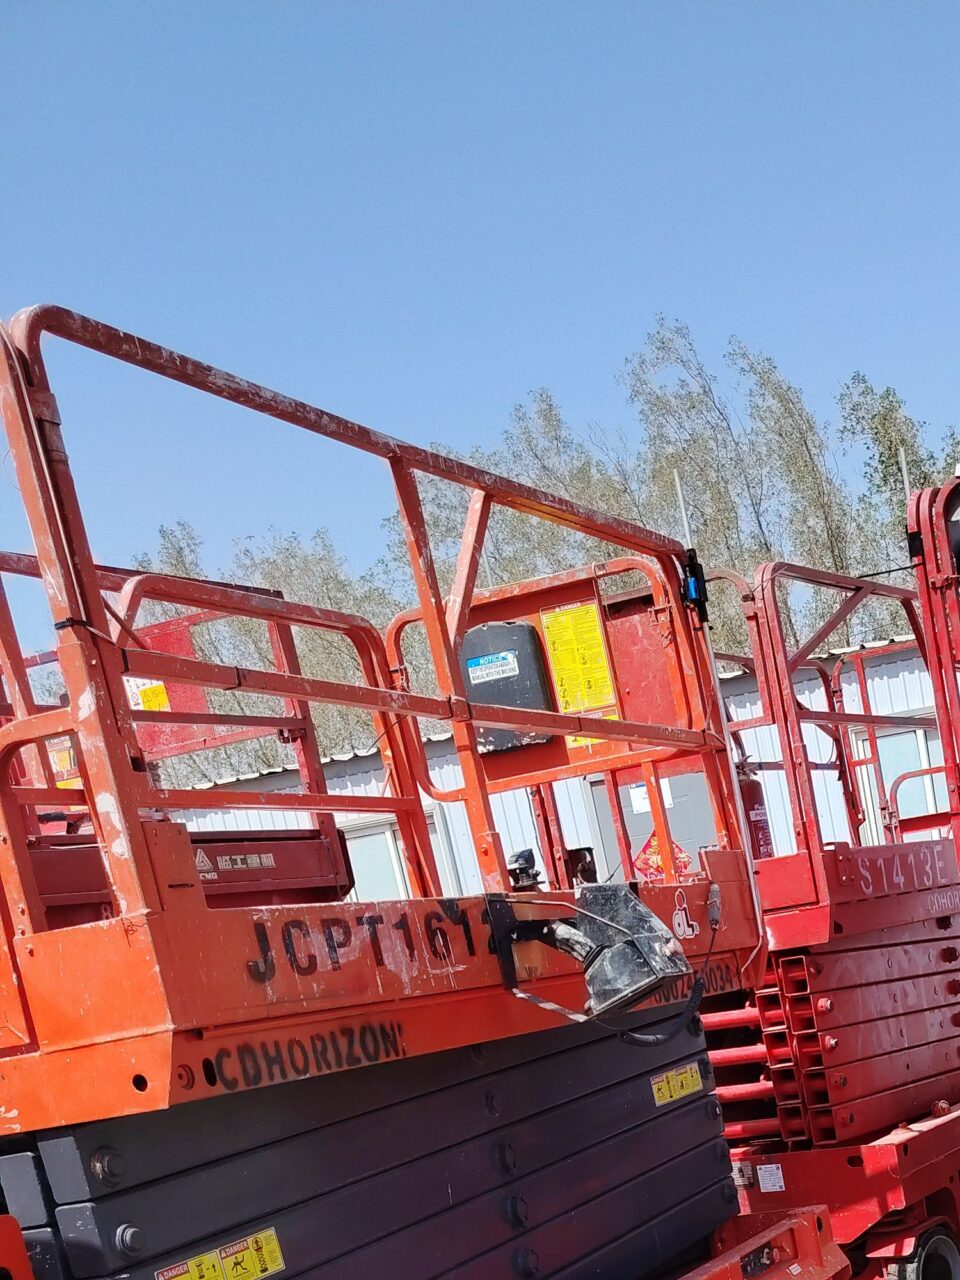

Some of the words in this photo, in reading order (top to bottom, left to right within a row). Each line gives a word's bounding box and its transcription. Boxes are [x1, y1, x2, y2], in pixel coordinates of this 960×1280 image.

[560, 602, 581, 611] DANGER
[479, 654, 504, 666] NOTICE
[857, 844, 948, 895] S1413E
[226, 1240, 248, 1256] DANGER
[163, 1263, 189, 1279] DANGER
